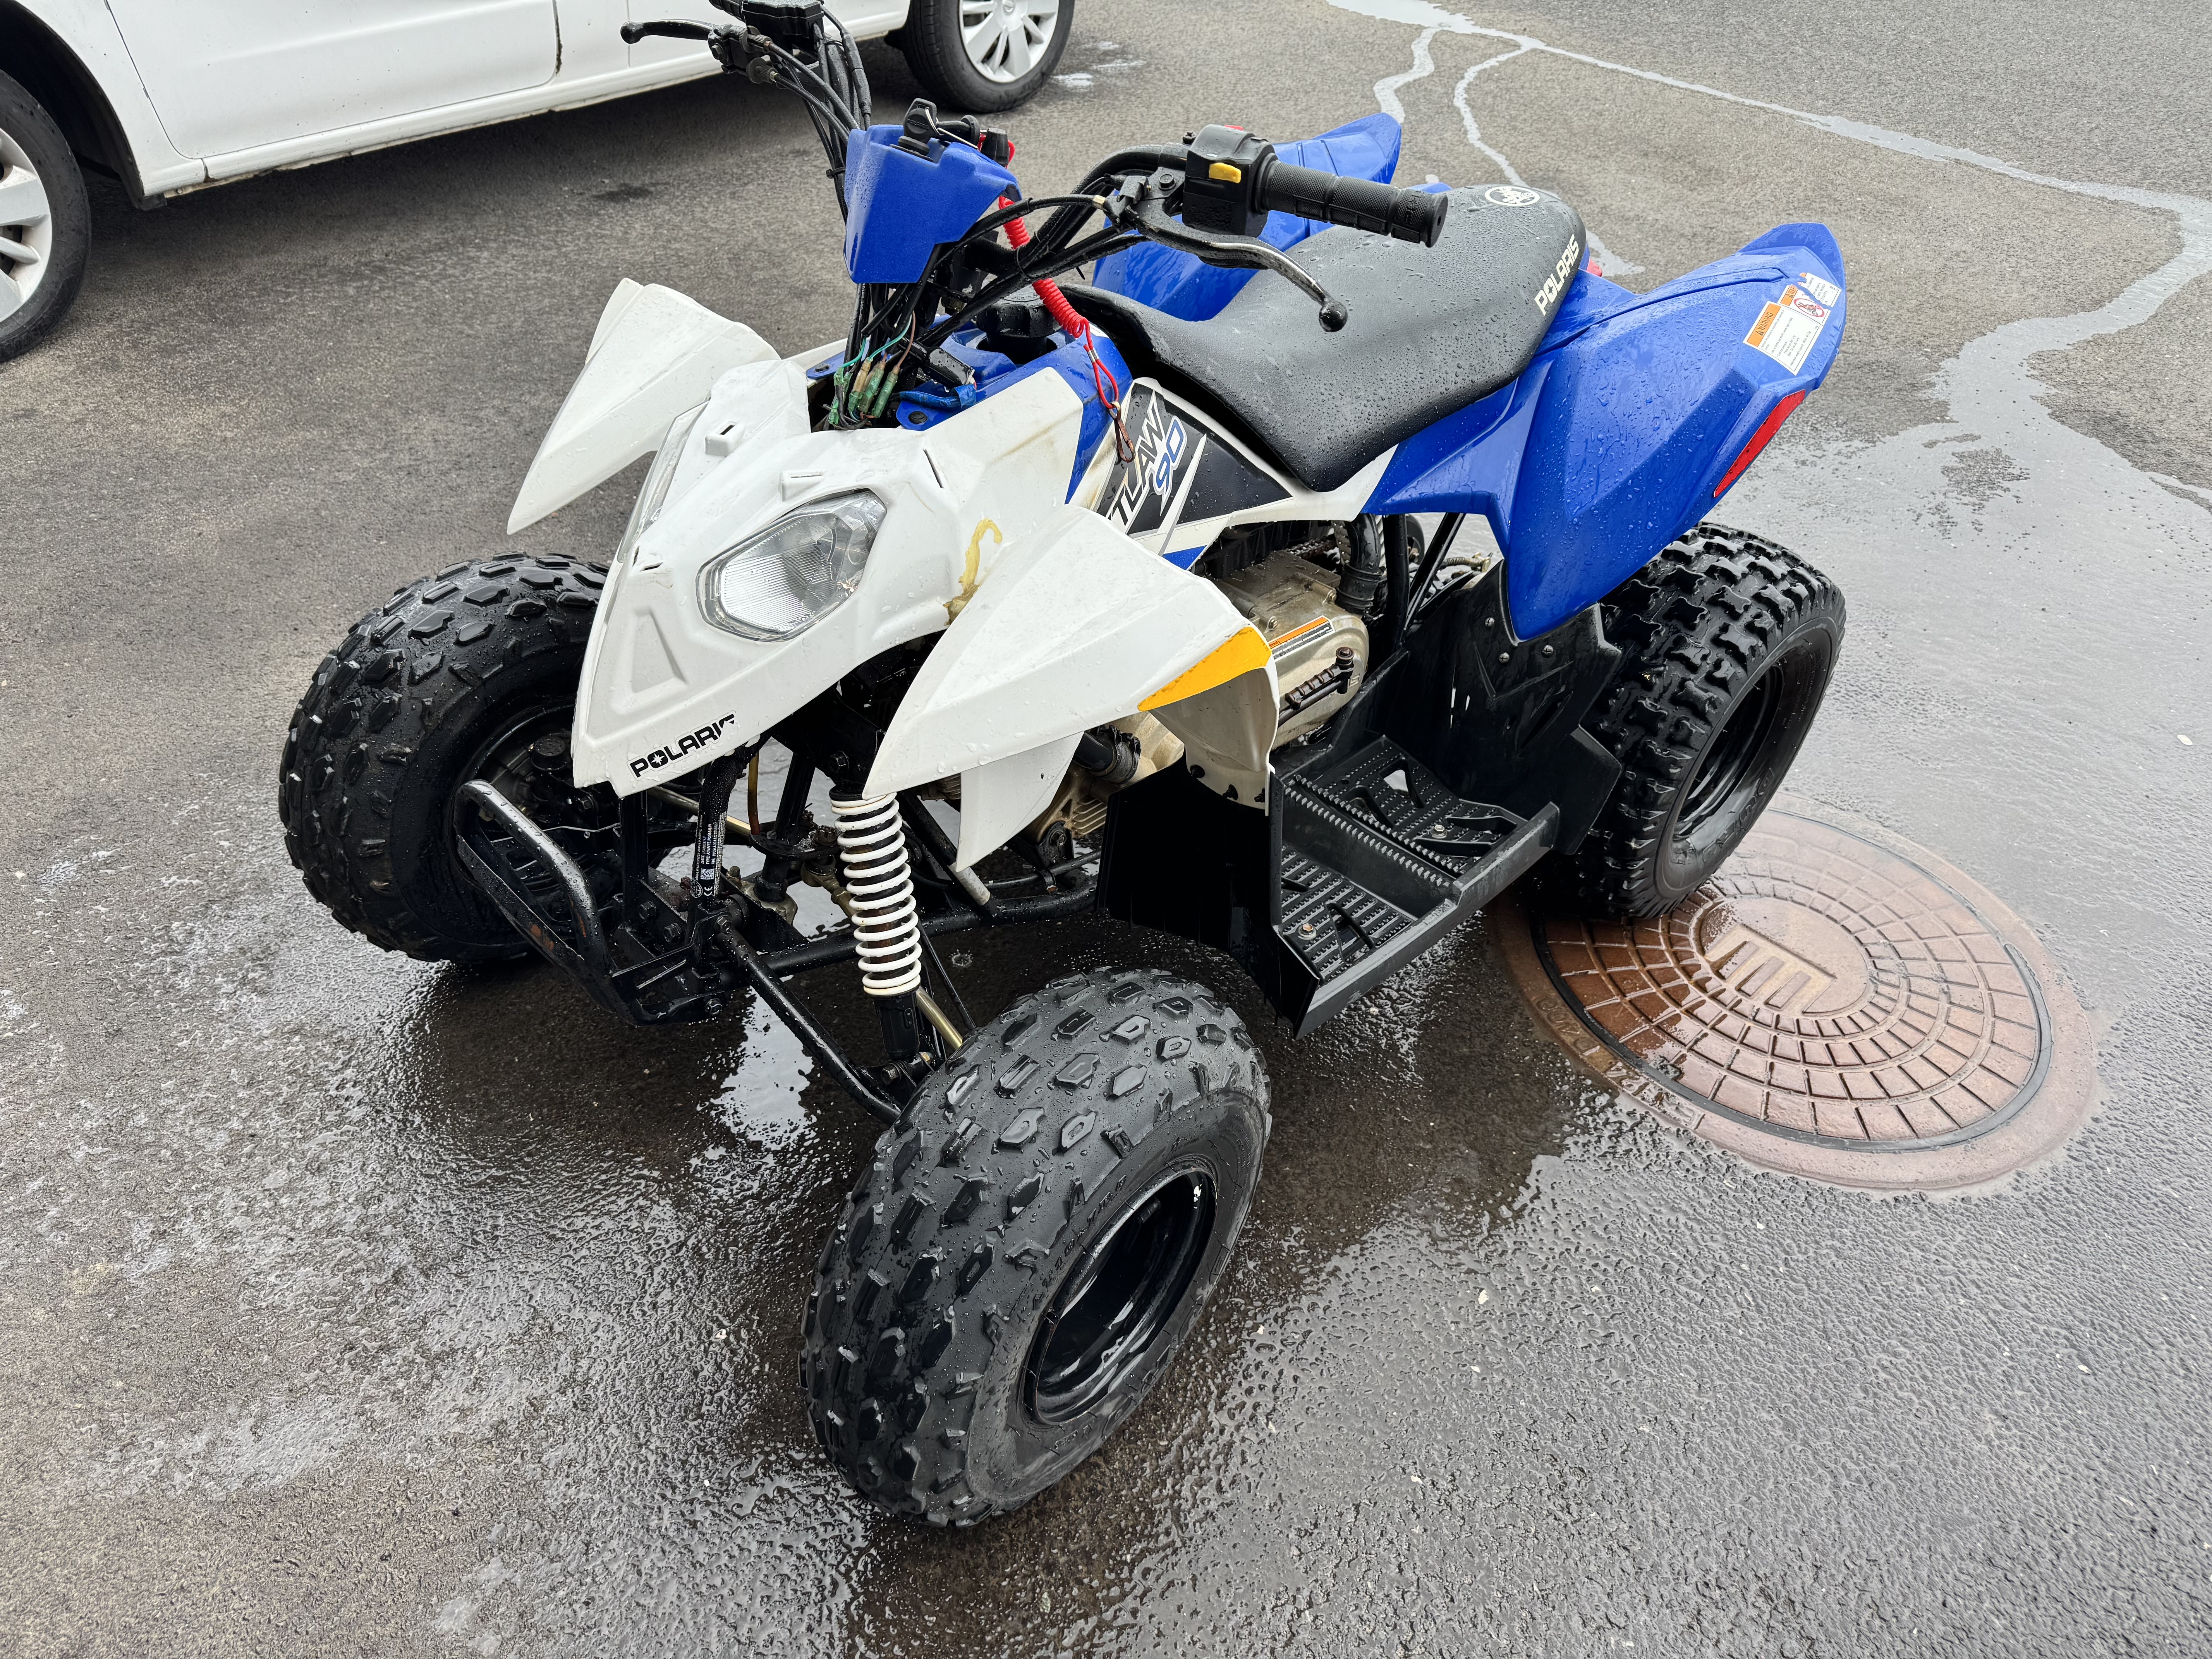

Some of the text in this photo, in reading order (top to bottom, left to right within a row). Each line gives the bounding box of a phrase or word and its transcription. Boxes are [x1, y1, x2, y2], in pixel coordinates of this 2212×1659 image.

[1534, 234, 1579, 316] POLARIS
[1758, 311, 1773, 330] WARNING
[1108, 402, 1164, 527] TLAW
[1156, 419, 1184, 495] 90
